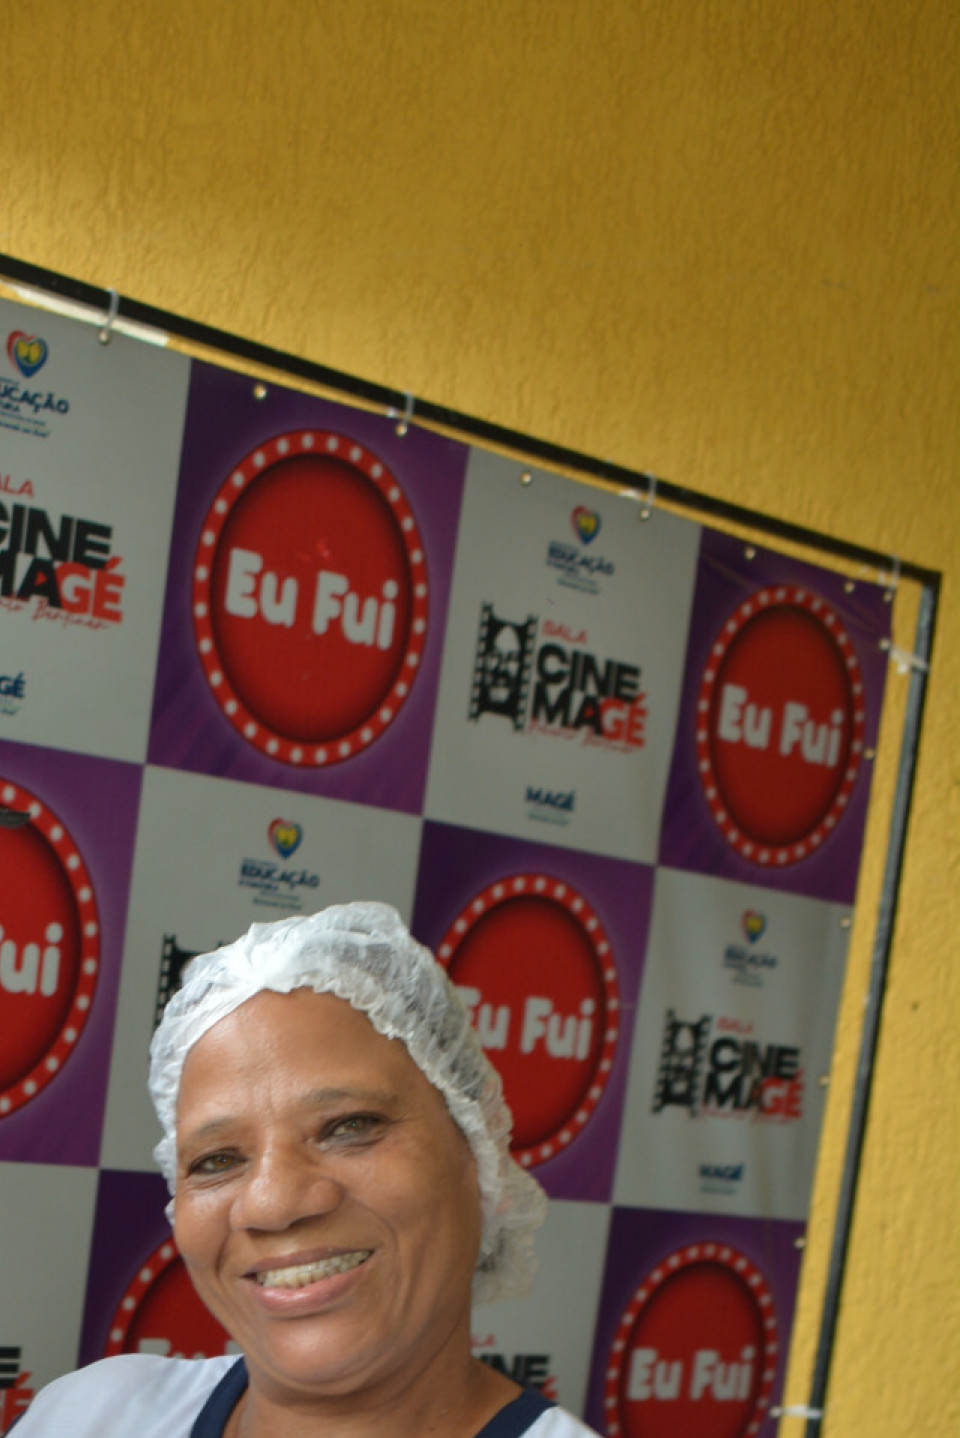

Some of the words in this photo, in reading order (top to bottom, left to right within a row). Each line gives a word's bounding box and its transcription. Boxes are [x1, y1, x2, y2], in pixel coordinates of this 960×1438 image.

[224, 547, 298, 628] Eu
[312, 570, 397, 651] Fui
[536, 643, 641, 704] CINE
[532, 679, 649, 749] MAGÉ
[717, 684, 770, 750] Eu
[780, 702, 843, 768] Fui
[521, 996, 596, 1061] Fui
[710, 1037, 800, 1080] CINE
[627, 1347, 682, 1401] Eu
[691, 1347, 754, 1401] Fui
